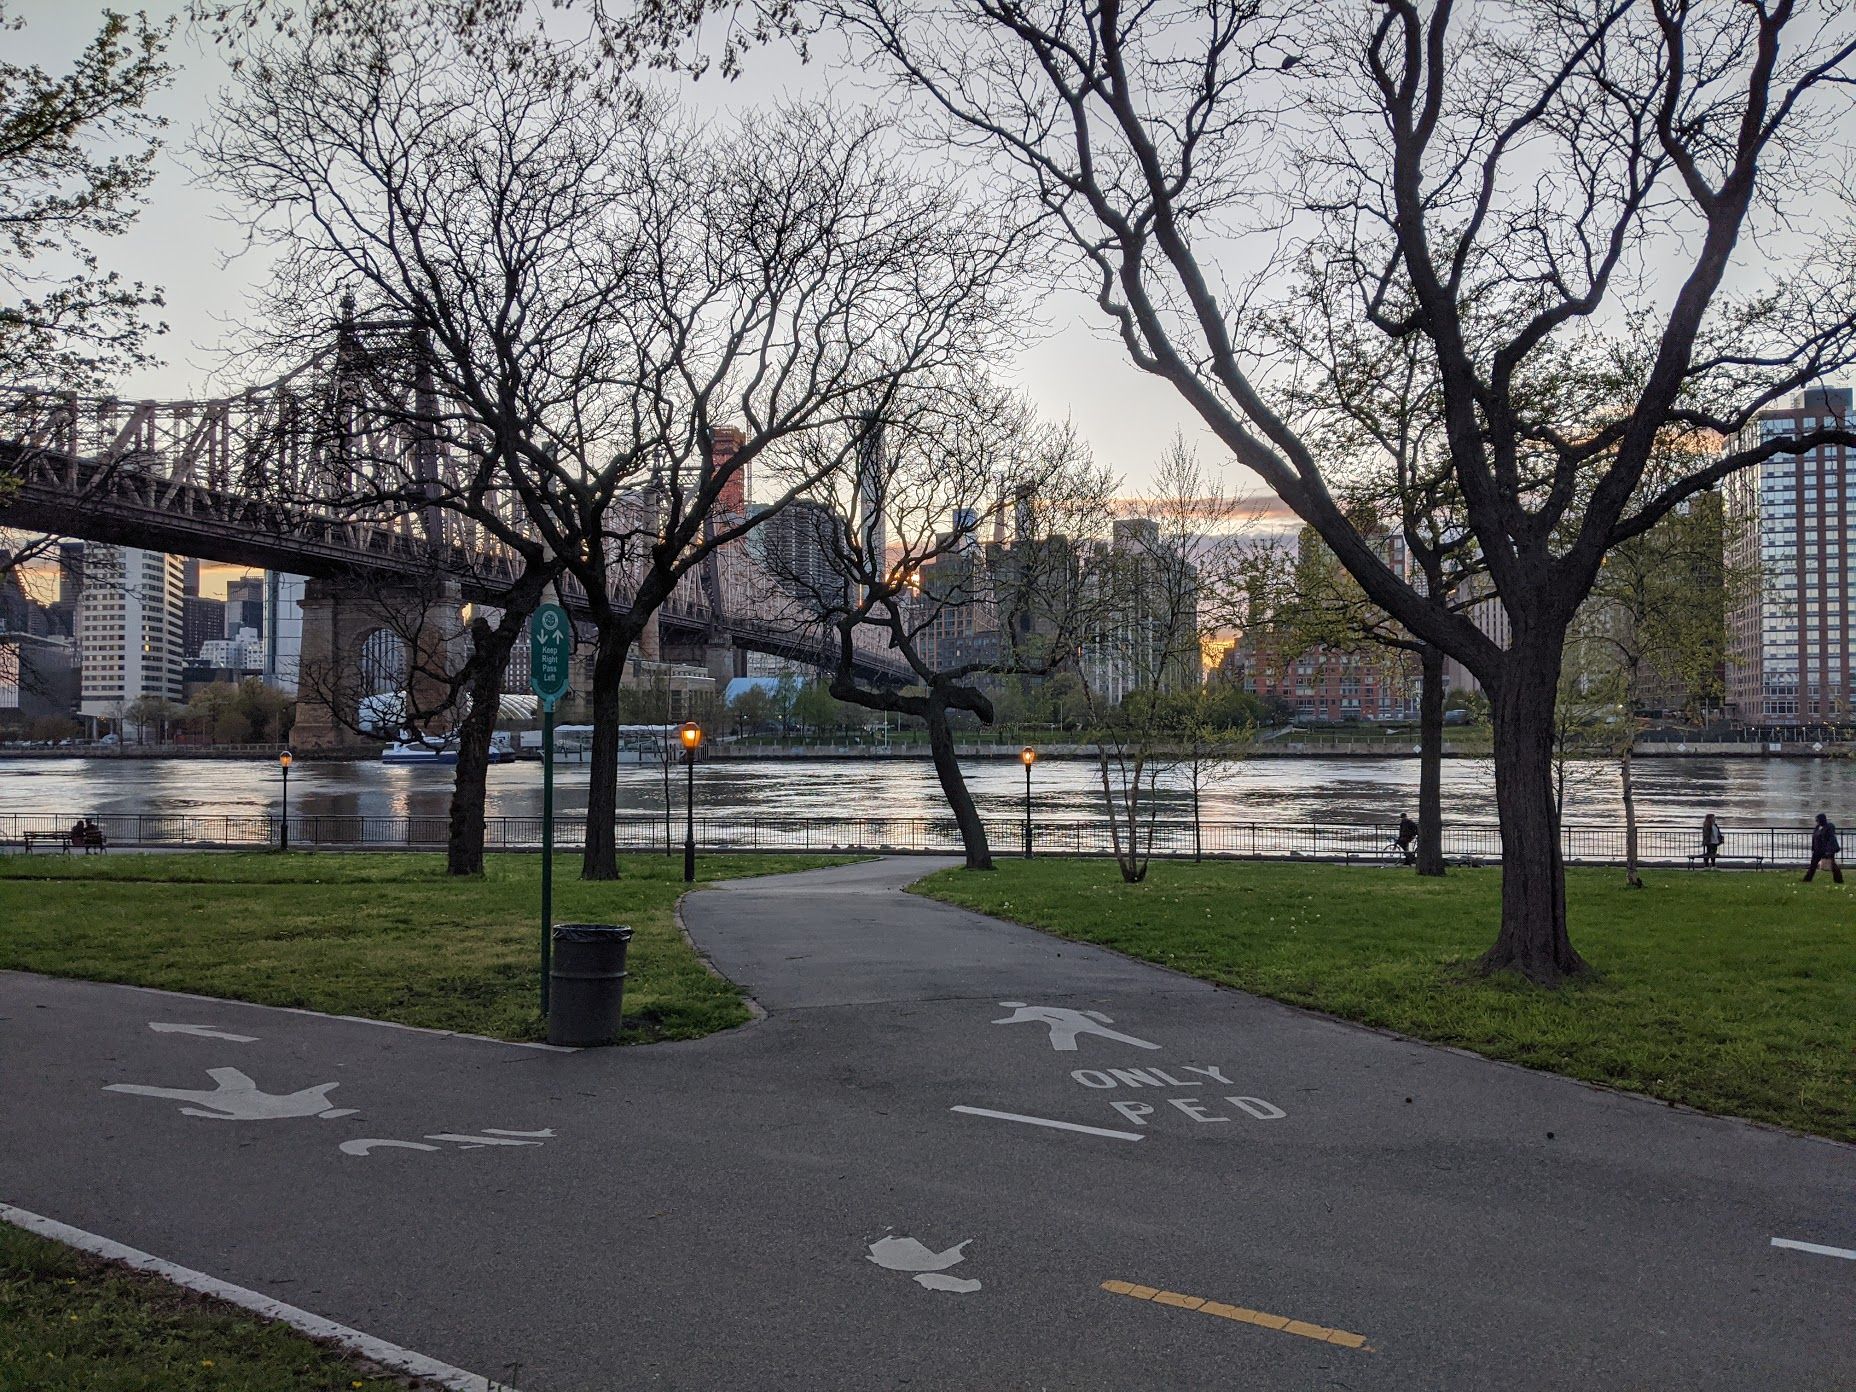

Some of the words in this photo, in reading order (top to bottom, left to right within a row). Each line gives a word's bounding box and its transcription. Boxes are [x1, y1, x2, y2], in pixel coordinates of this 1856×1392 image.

[542, 646, 558, 655] Keep
[542, 655, 558, 665] Right
[542, 664, 557, 672] Pass
[544, 673, 556, 682] Left
[1070, 1066, 1234, 1089] ONLY
[1109, 1096, 1287, 1125] PED
